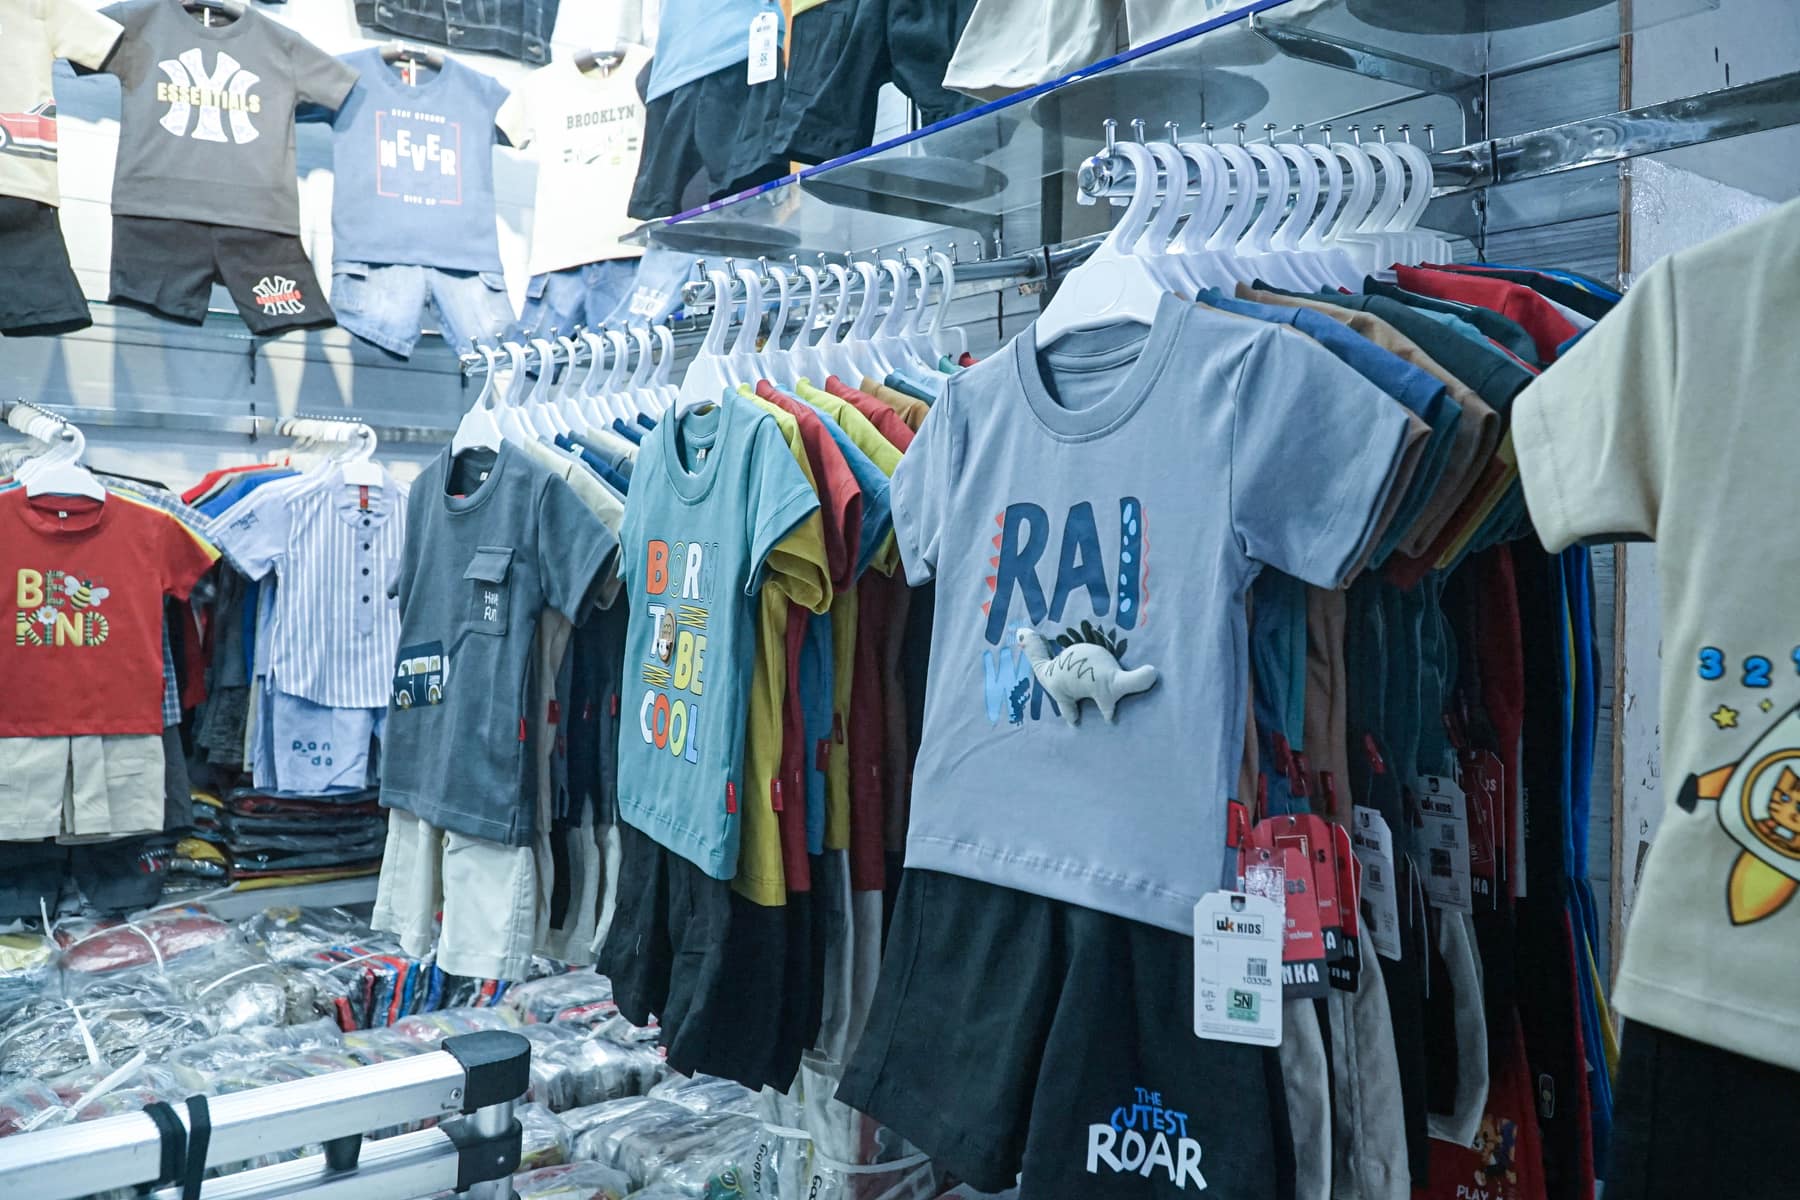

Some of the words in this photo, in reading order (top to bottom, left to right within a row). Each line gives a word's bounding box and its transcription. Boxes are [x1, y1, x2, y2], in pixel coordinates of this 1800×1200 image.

[157, 82, 261, 113] ESSENTIALS
[566, 104, 635, 129] BROOKLYN
[380, 129, 456, 176] NEVER
[16, 568, 65, 608] BE
[646, 539, 719, 604] BORN
[16, 610, 109, 646] KIND
[673, 629, 707, 696] BE
[1699, 646, 1725, 681] 3
[1742, 655, 1773, 688] 2
[640, 688, 699, 765] COOL
[1237, 922, 1262, 935] KIDS
[1134, 1087, 1162, 1106] THE
[1110, 1103, 1188, 1138] CUTEST
[1086, 1123, 1208, 1191] ROAR
